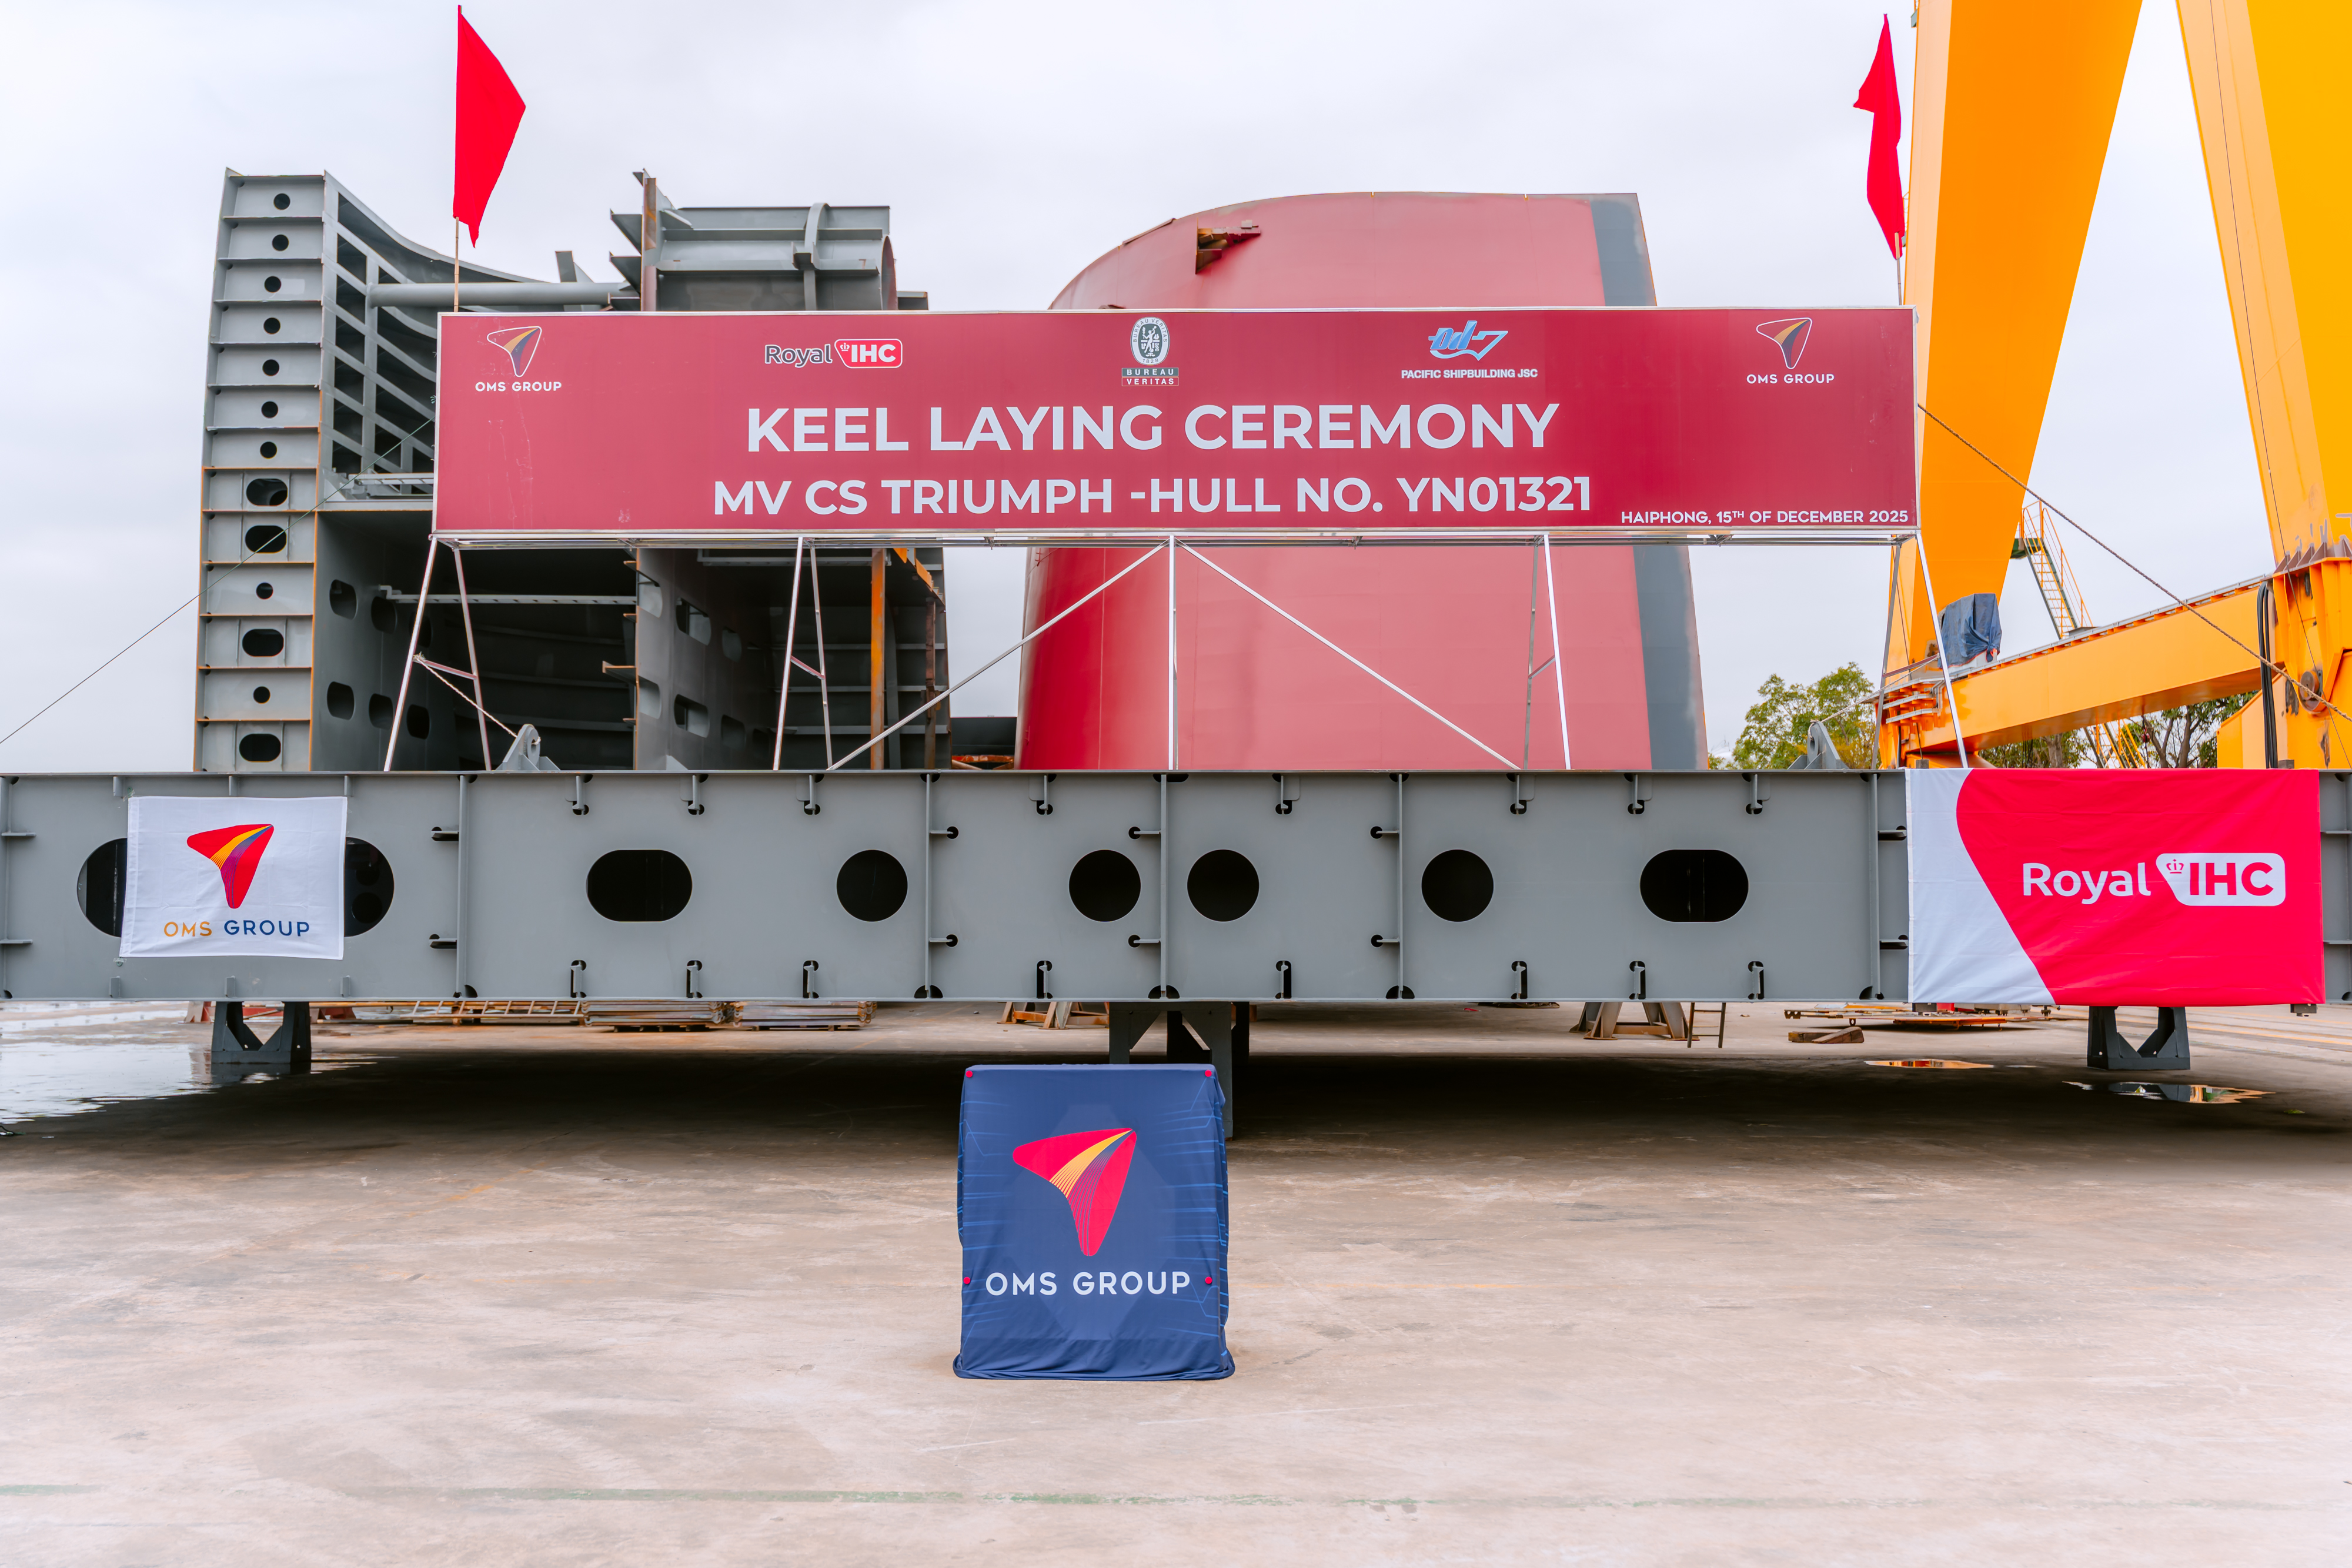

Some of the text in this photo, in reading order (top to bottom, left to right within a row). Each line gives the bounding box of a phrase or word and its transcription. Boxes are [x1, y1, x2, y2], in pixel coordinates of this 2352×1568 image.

[1133, 319, 1167, 343] BUREAU VERITAS
[765, 344, 896, 368] Royal IHC
[1401, 369, 1538, 378] PACIFIC SHIPBUILDING JSC
[1746, 374, 1835, 384] OMS GROUP
[475, 382, 562, 392] OMS GROUP
[748, 403, 1560, 452] KEEL LAYING CEREMONY
[714, 481, 792, 515] MV
[805, 480, 867, 514] CS
[881, 479, 1112, 514] TRIUMPH
[1297, 477, 1384, 512] NO.
[1396, 476, 1590, 511] YN01321
[1621, 511, 1712, 524] HAIPHONG,
[1749, 510, 1772, 523] OF
[1777, 510, 1864, 523] DECEMBER
[1869, 510, 1909, 523] 2025
[2023, 862, 2274, 905] Royal IHC
[163, 920, 310, 937] OMS GROUP
[985, 1271, 1190, 1295] OMS GROUP
